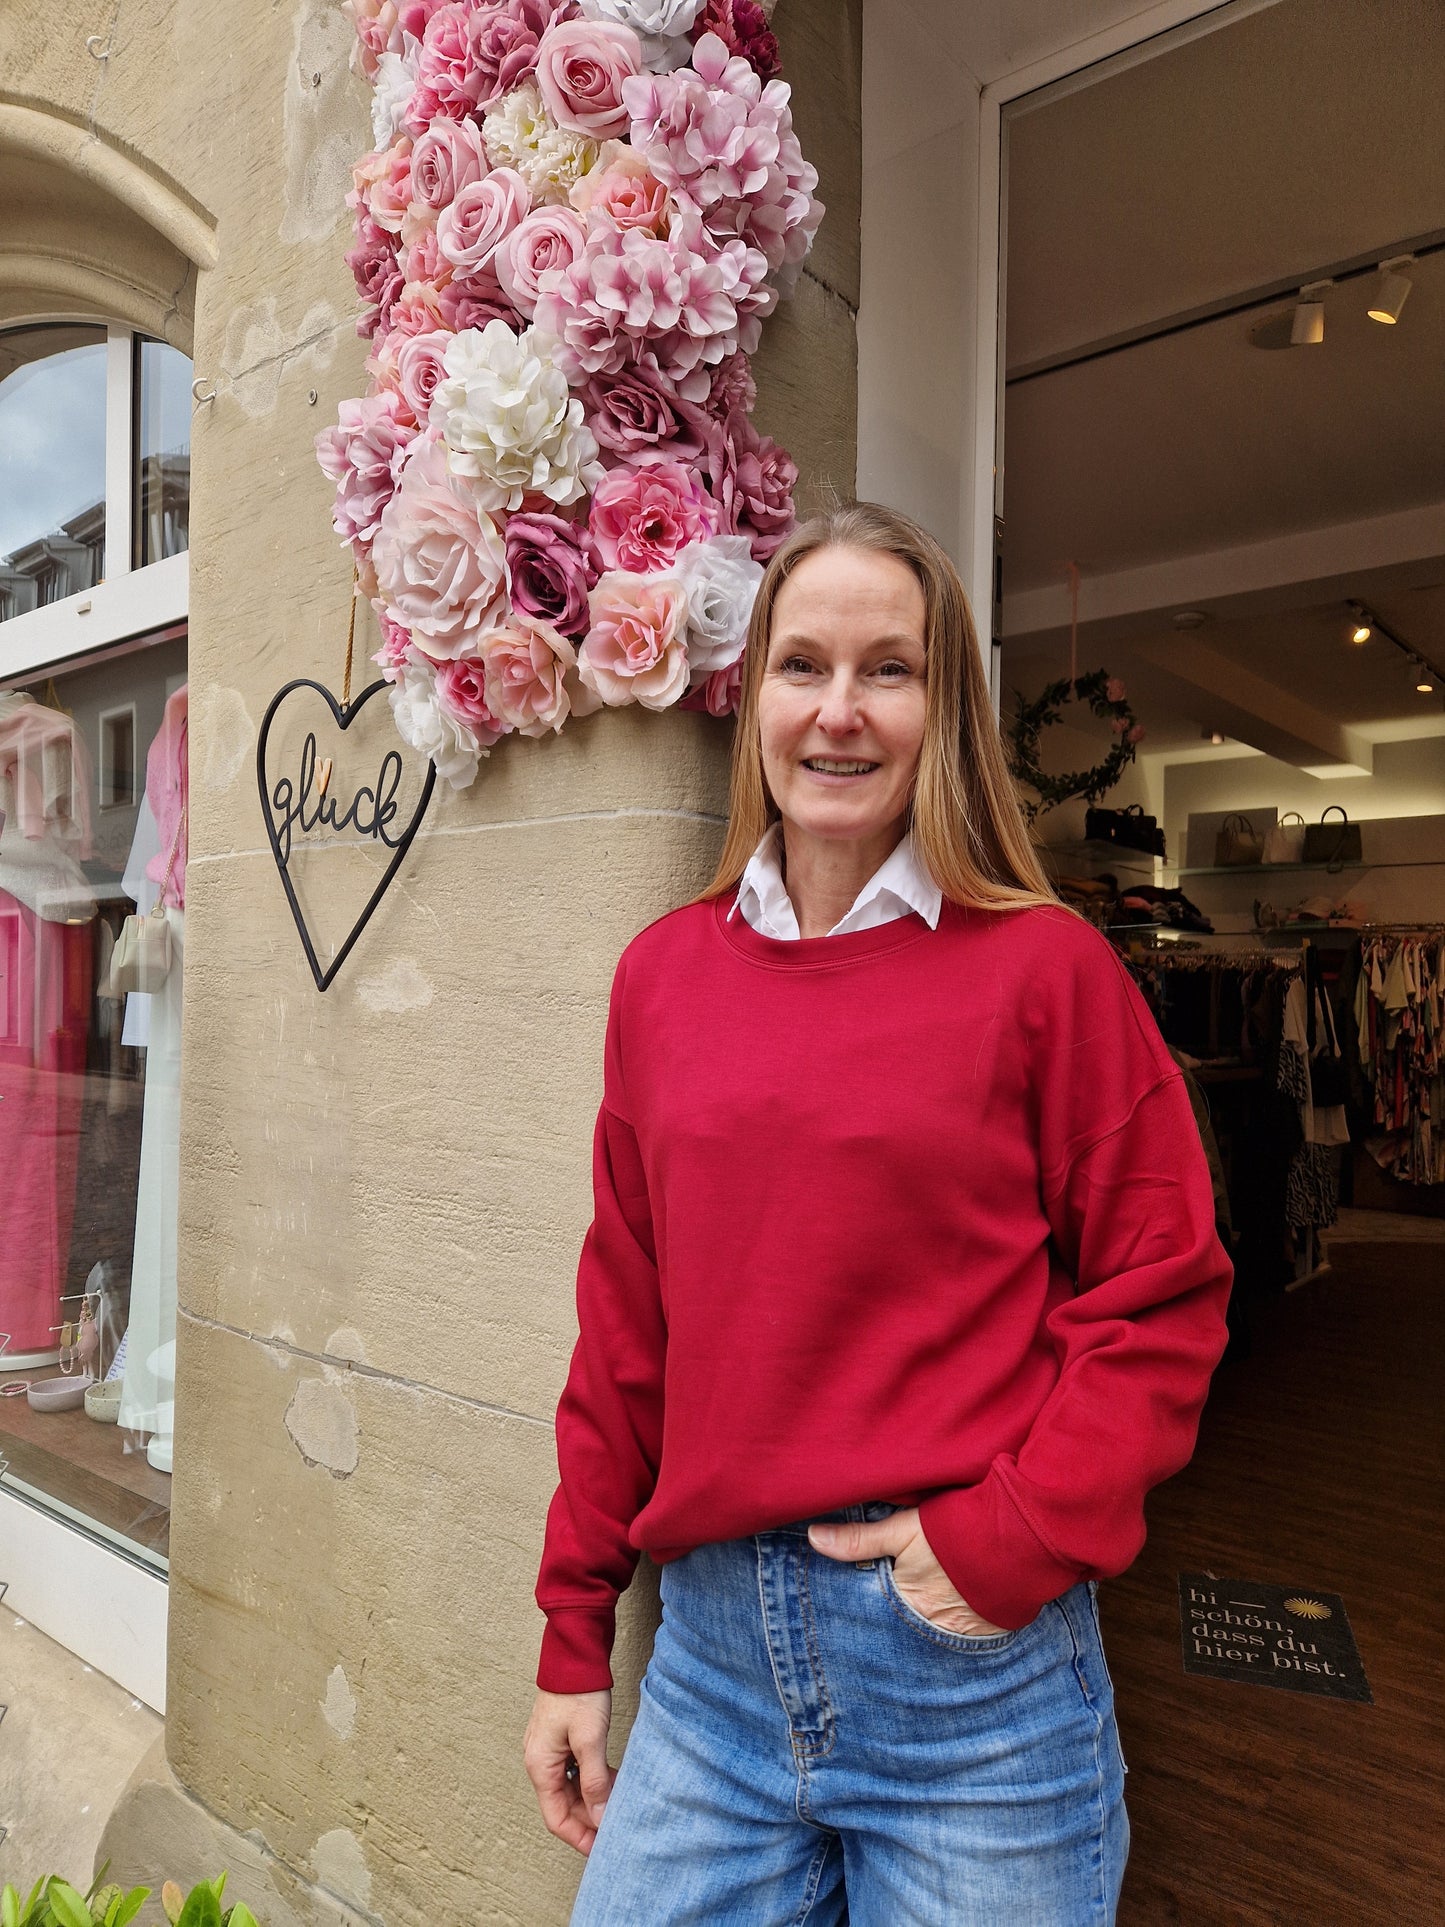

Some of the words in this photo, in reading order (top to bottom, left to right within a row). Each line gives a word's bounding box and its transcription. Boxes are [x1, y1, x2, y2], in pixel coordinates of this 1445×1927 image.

[1189, 1588, 1218, 1605] hi
[1190, 1608, 1294, 1635] schön,
[1191, 1623, 1265, 1647] dass
[1277, 1636, 1320, 1655] du
[1193, 1639, 1260, 1663] hier
[1272, 1651, 1346, 1678] bist.
